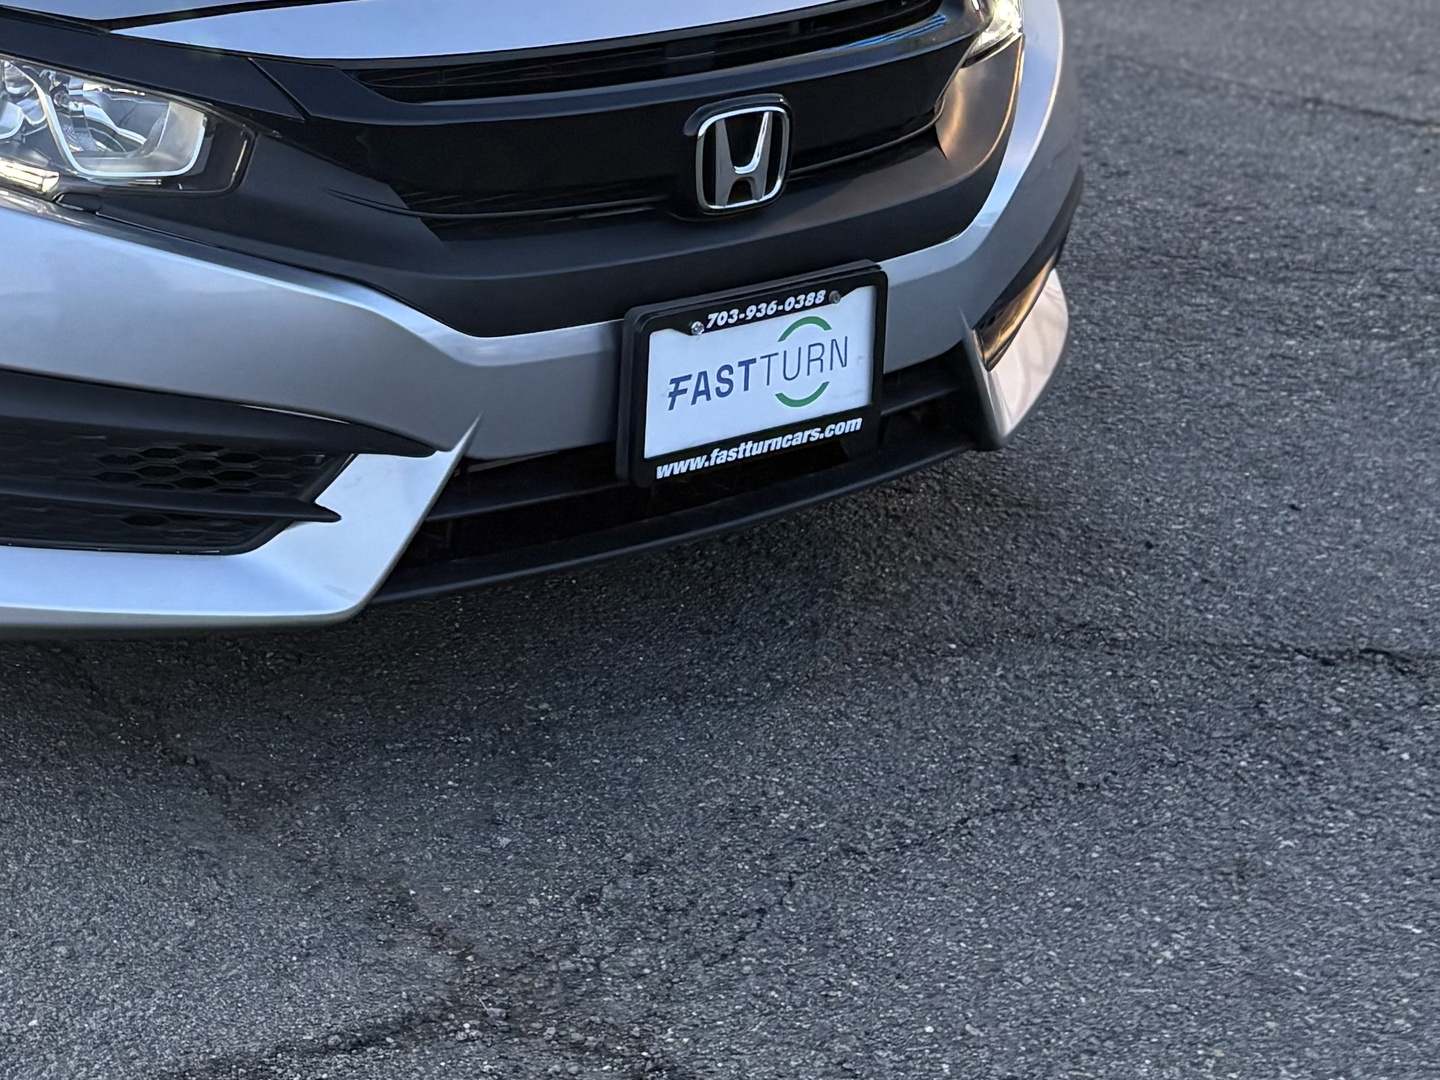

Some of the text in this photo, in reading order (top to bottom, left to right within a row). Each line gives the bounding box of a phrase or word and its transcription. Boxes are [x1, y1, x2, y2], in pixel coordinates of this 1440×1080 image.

[706, 289, 827, 329] 703-936-0388
[667, 335, 848, 411] FASTTURN
[656, 417, 863, 479] www.fastturncars.com
